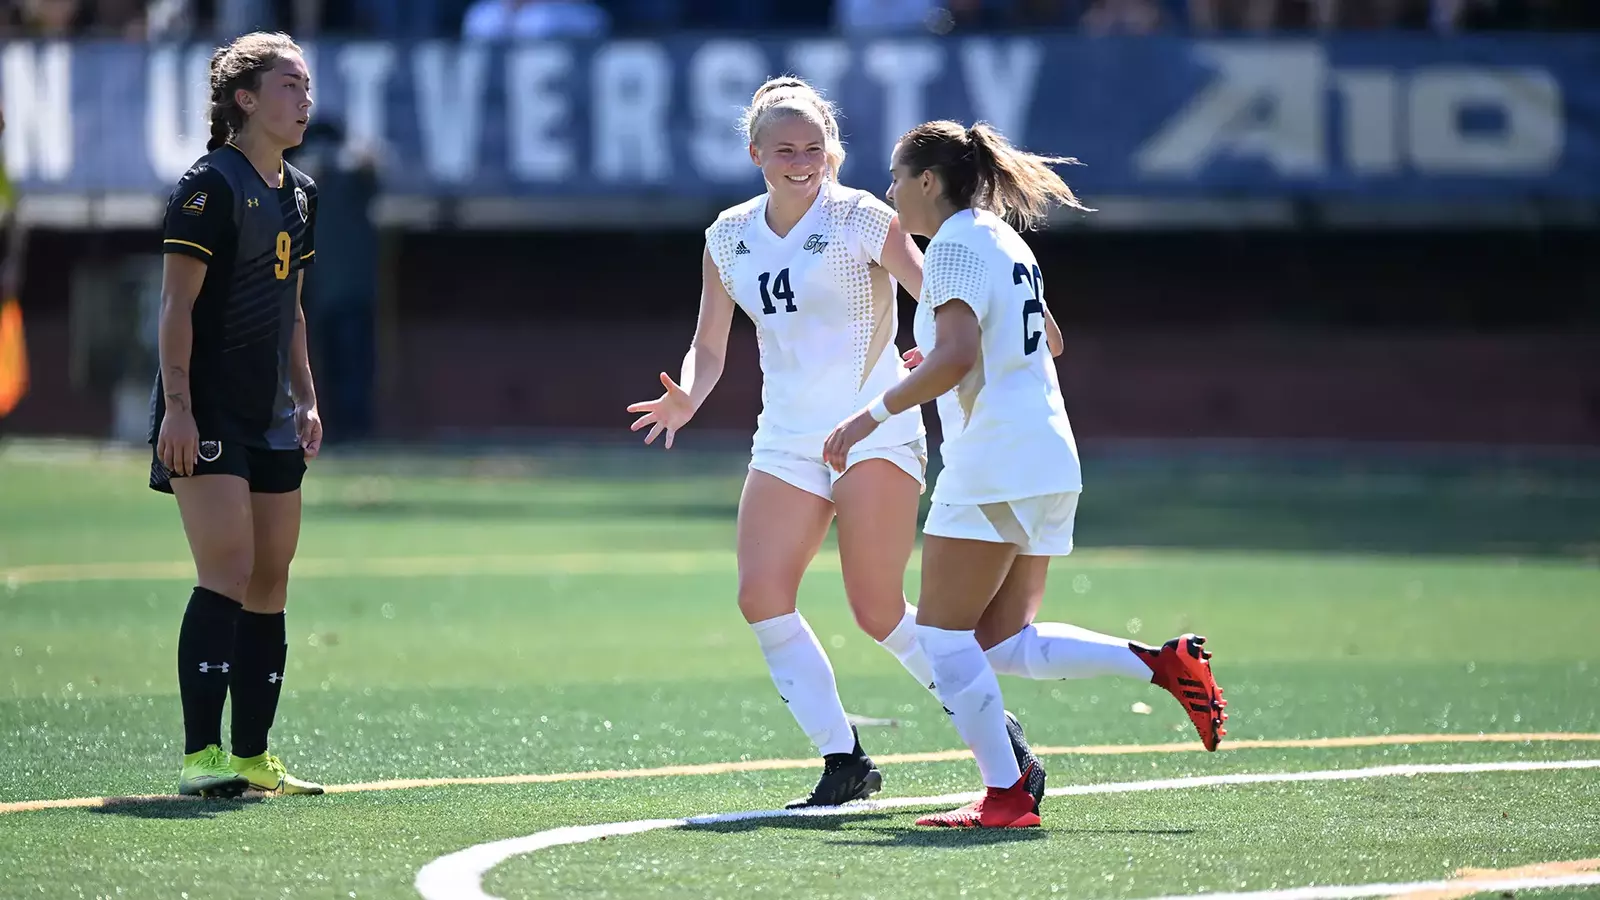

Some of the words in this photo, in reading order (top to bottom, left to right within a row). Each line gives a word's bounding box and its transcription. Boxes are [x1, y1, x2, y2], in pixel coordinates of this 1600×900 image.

[146, 38, 1044, 184] UIVERSTY
[1134, 40, 1565, 176] A10
[274, 231, 292, 280] 9
[757, 267, 798, 315] 14
